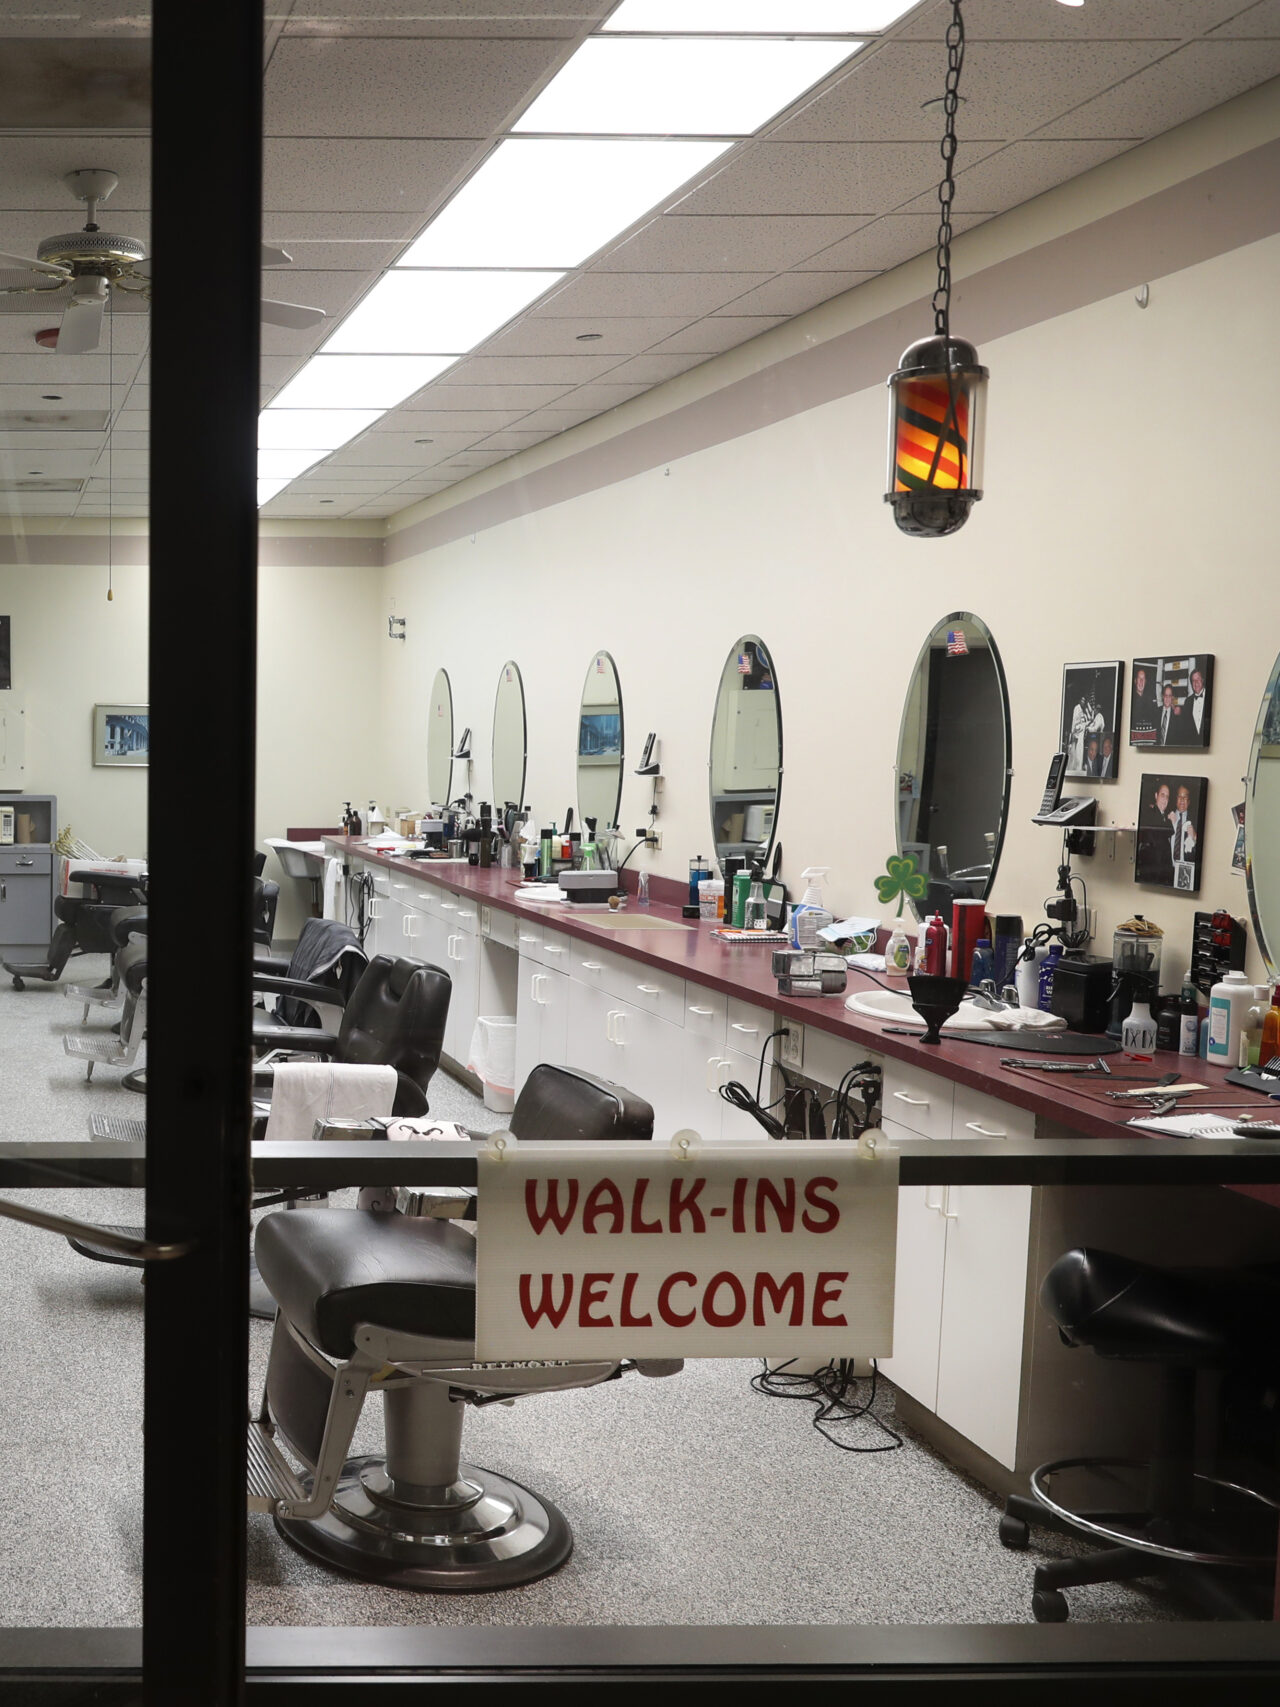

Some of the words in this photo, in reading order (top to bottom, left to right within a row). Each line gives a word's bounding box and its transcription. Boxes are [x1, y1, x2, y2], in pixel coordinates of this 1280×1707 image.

[524, 1176, 841, 1235] WALK-INS
[519, 1271, 849, 1329] WELCOME
[472, 1360, 569, 1370] BELMONT
